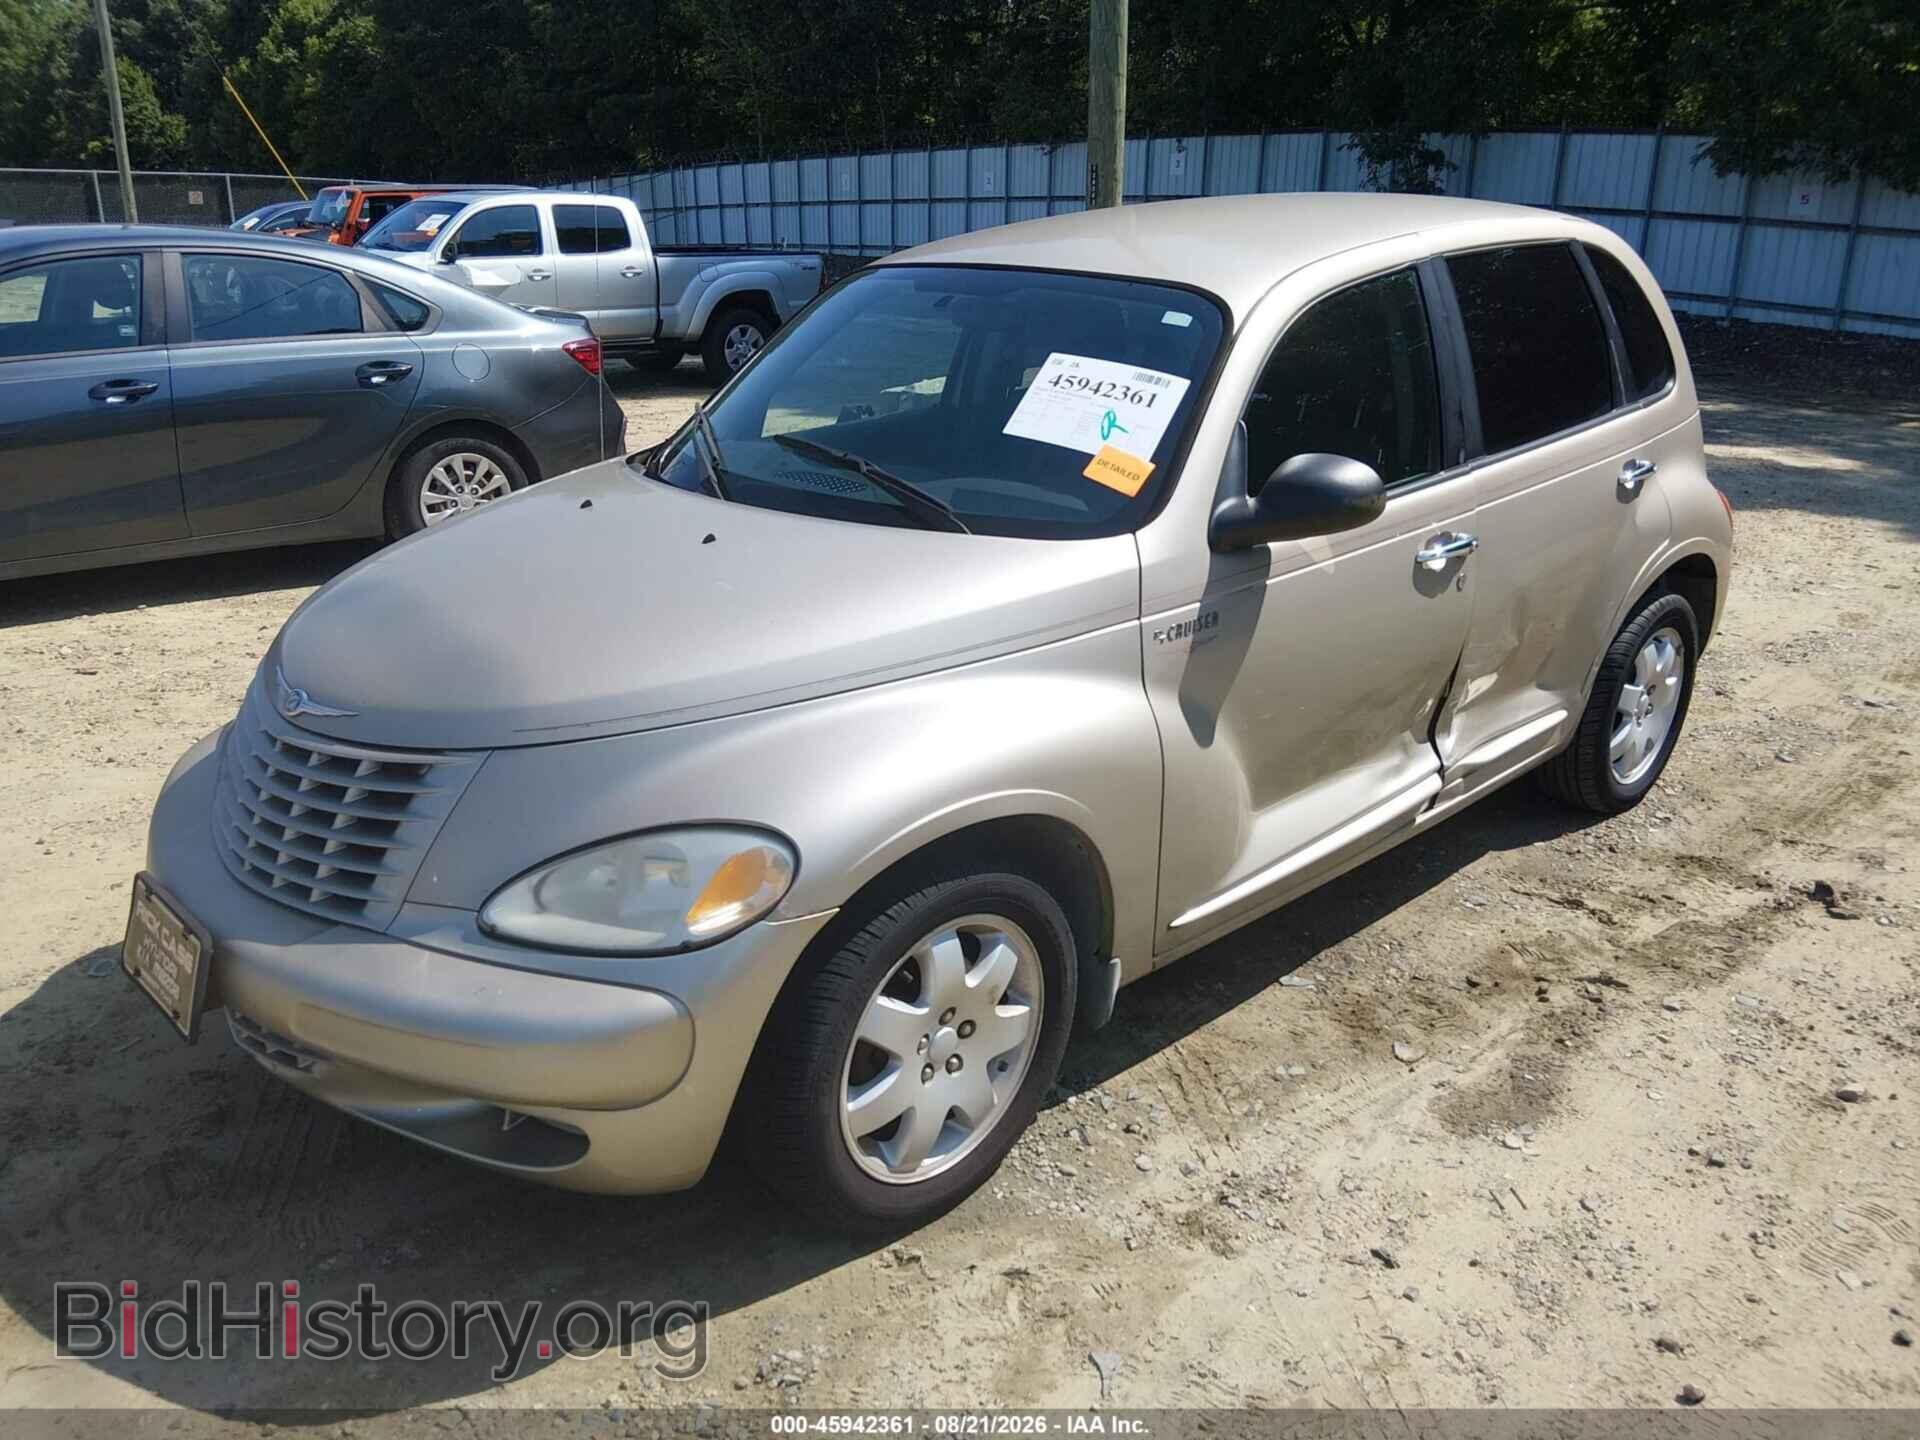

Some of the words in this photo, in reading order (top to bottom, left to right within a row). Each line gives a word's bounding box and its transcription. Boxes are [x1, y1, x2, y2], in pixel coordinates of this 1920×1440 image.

[1048, 373, 1157, 408] 45942361
[1096, 458, 1140, 481] DETAILED
[1167, 611, 1219, 642] CRUISER
